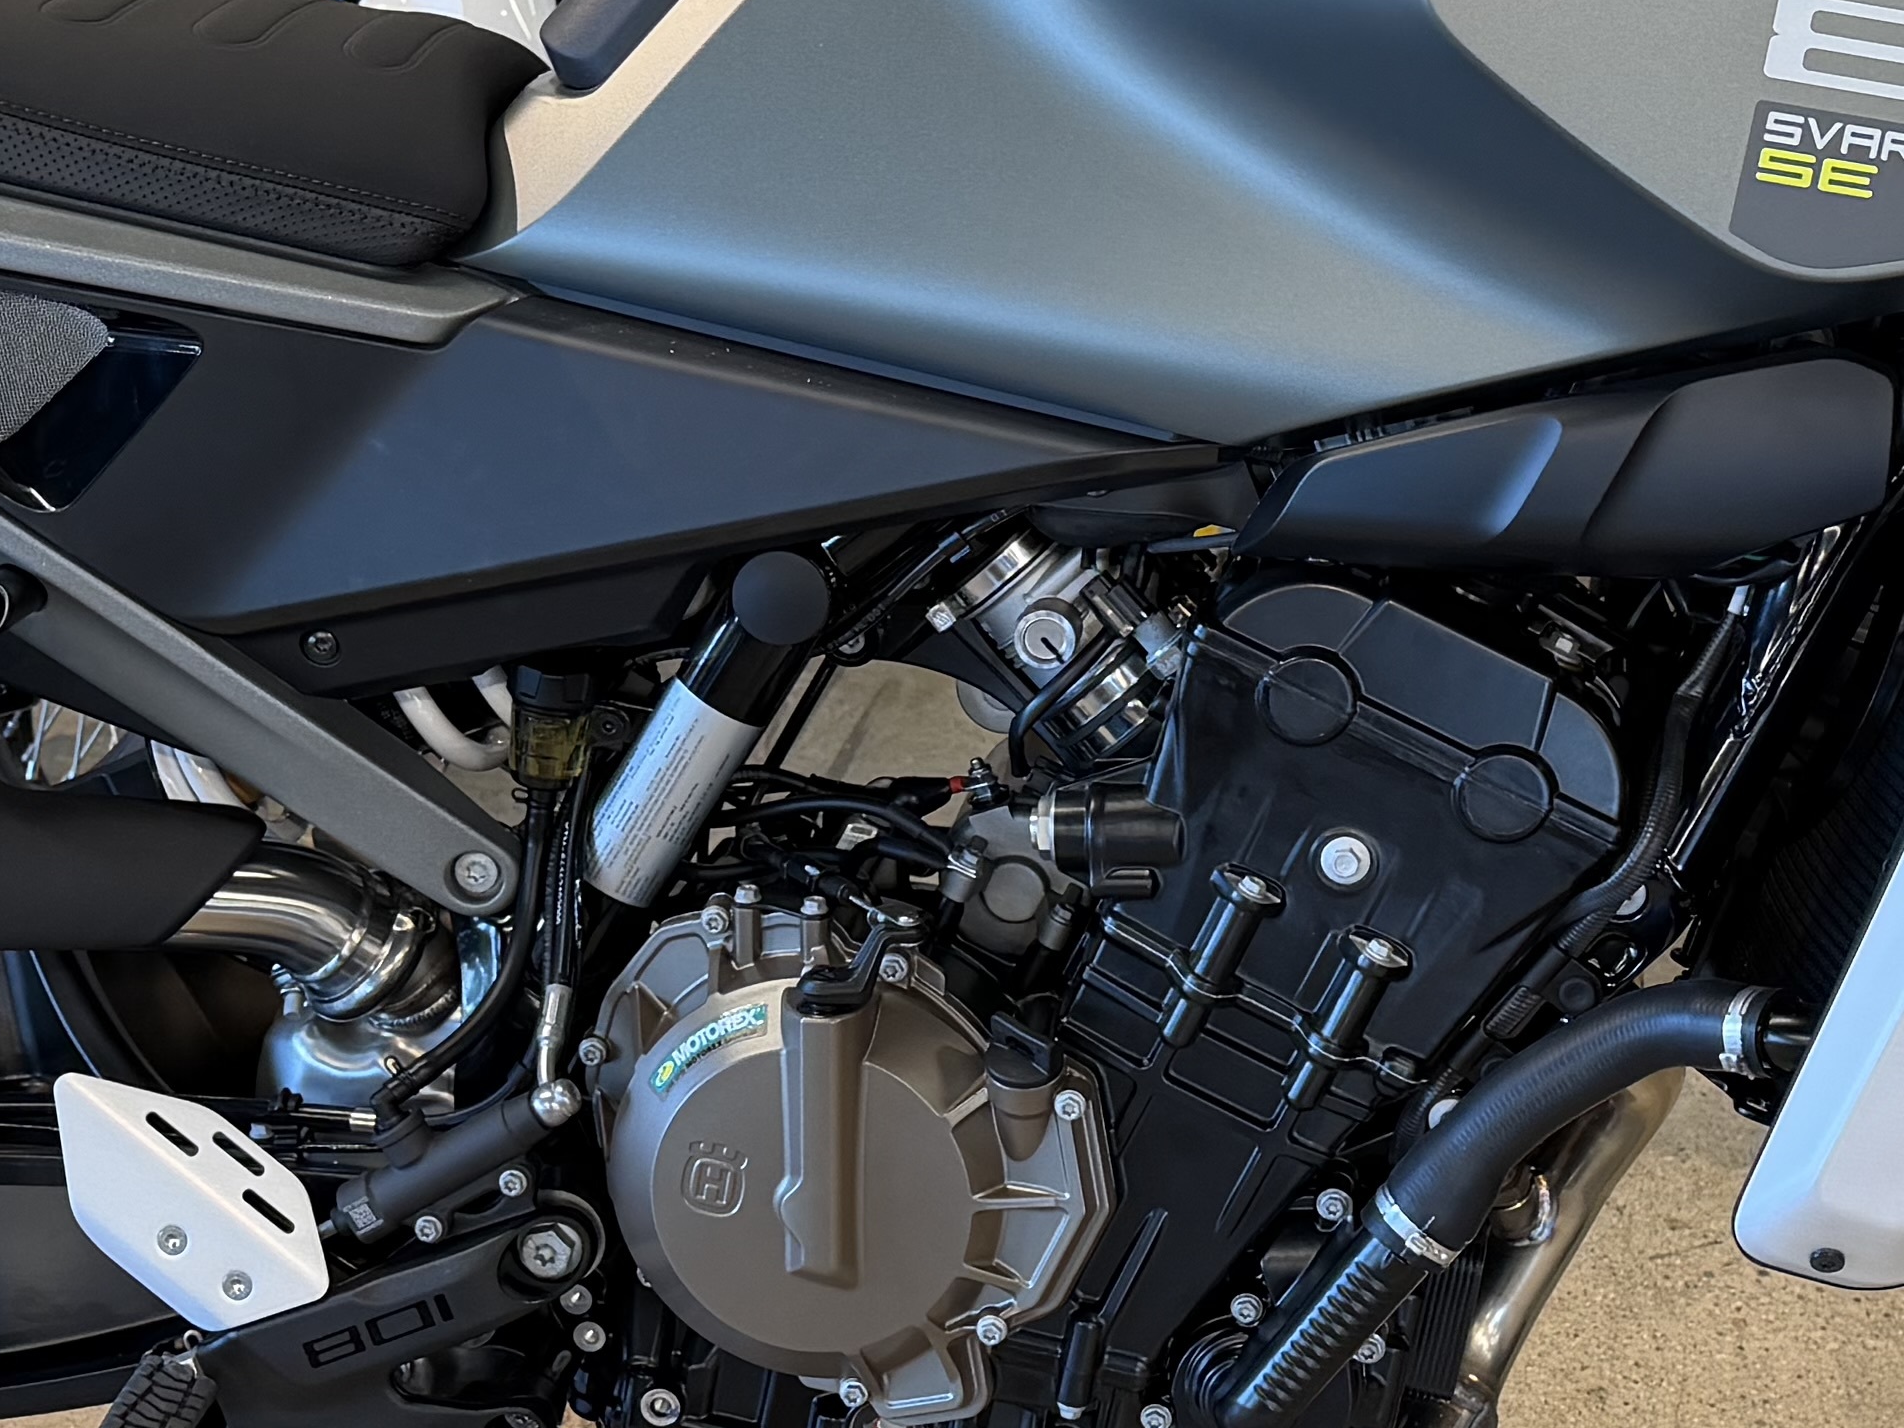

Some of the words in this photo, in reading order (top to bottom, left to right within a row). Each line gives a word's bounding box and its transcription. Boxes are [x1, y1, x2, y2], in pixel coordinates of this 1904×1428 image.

[1755, 147, 1880, 201] SE
[671, 1007, 761, 1067] MOTOREX
[303, 1294, 456, 1369] 801
